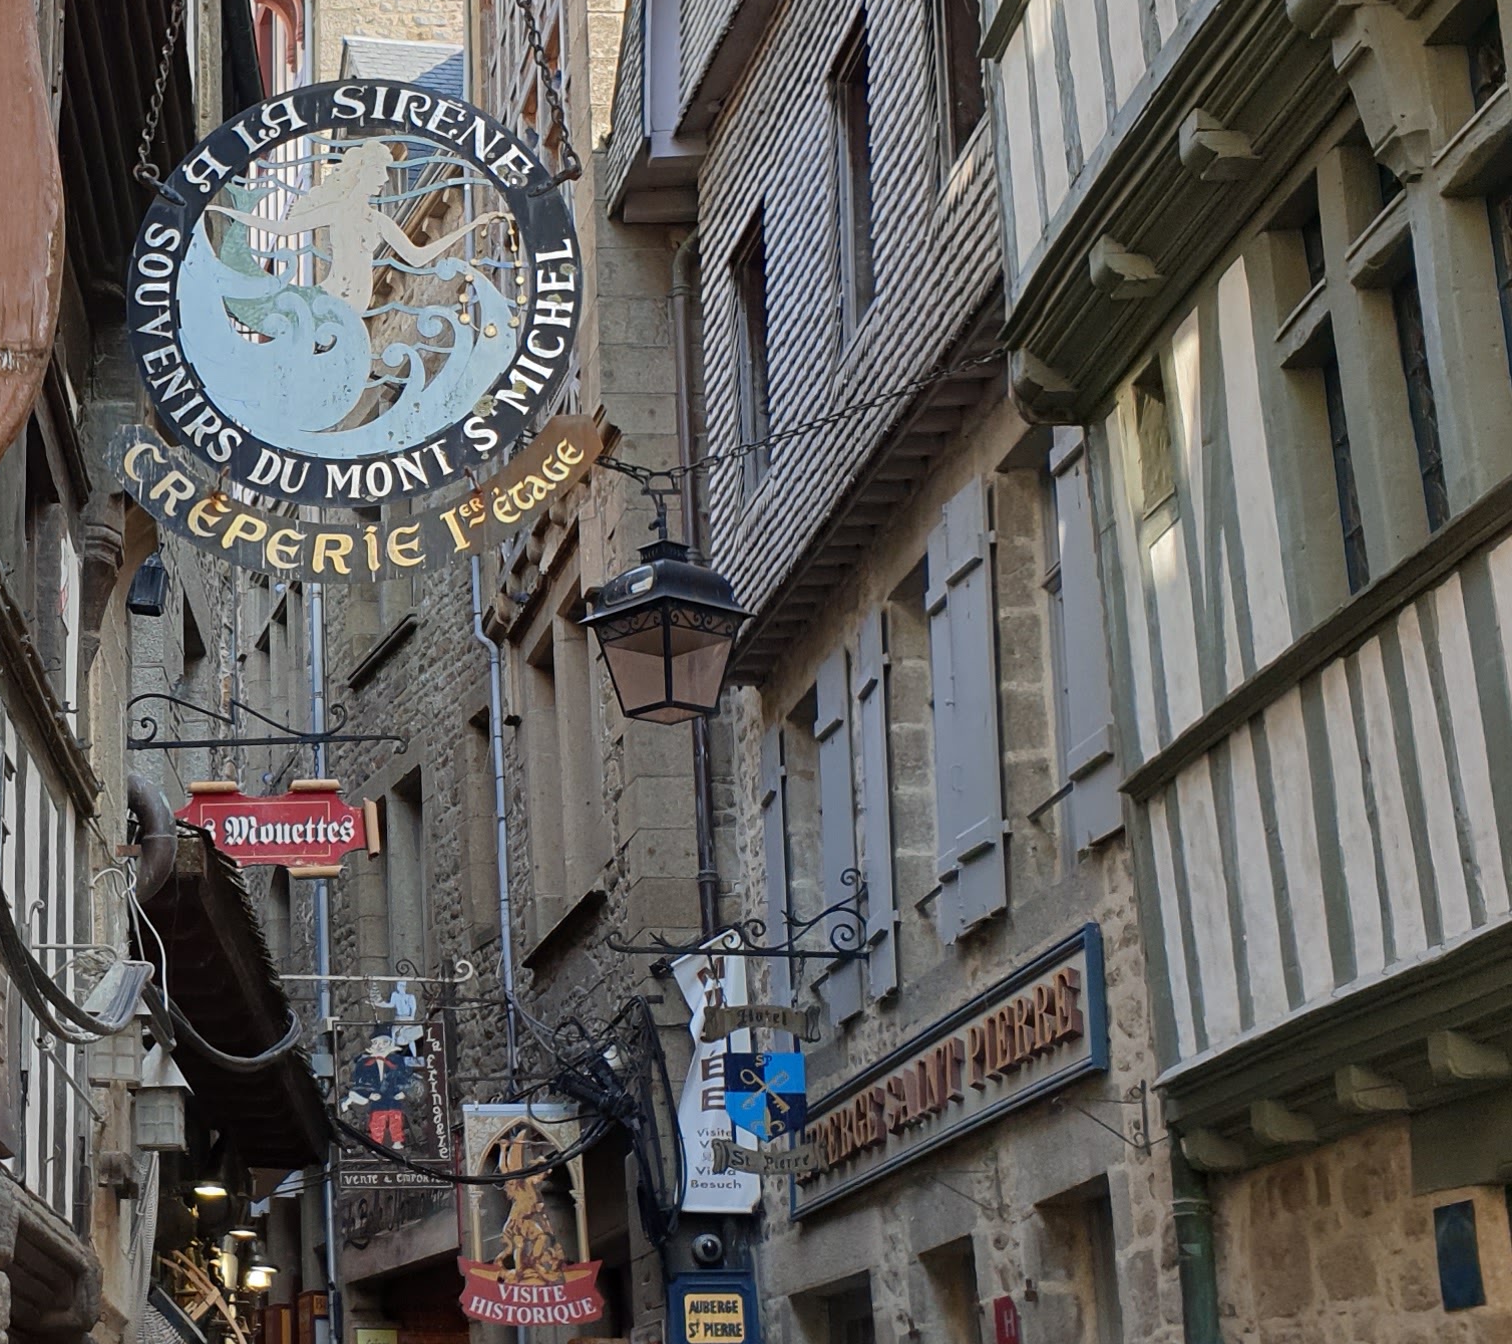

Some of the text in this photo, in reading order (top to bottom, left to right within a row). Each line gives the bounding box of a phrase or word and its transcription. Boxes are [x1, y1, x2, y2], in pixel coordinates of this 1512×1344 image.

[231, 96, 308, 154] LA
[134, 223, 243, 463] SOUVENIRS
[247, 448, 311, 493] DU
[325, 439, 454, 498] MONT
[496, 238, 575, 416] MICHEL
[225, 815, 355, 845] Mouettes
[887, 1036, 965, 1134] SAINT
[966, 966, 1084, 1090] PIERRE
[690, 1179, 743, 1189] Besuch
[498, 1284, 567, 1303] VISITE
[689, 1299, 739, 1314] AUBERGE
[469, 1296, 597, 1324] HISTORIQUE
[703, 1322, 743, 1338] PIERRE
